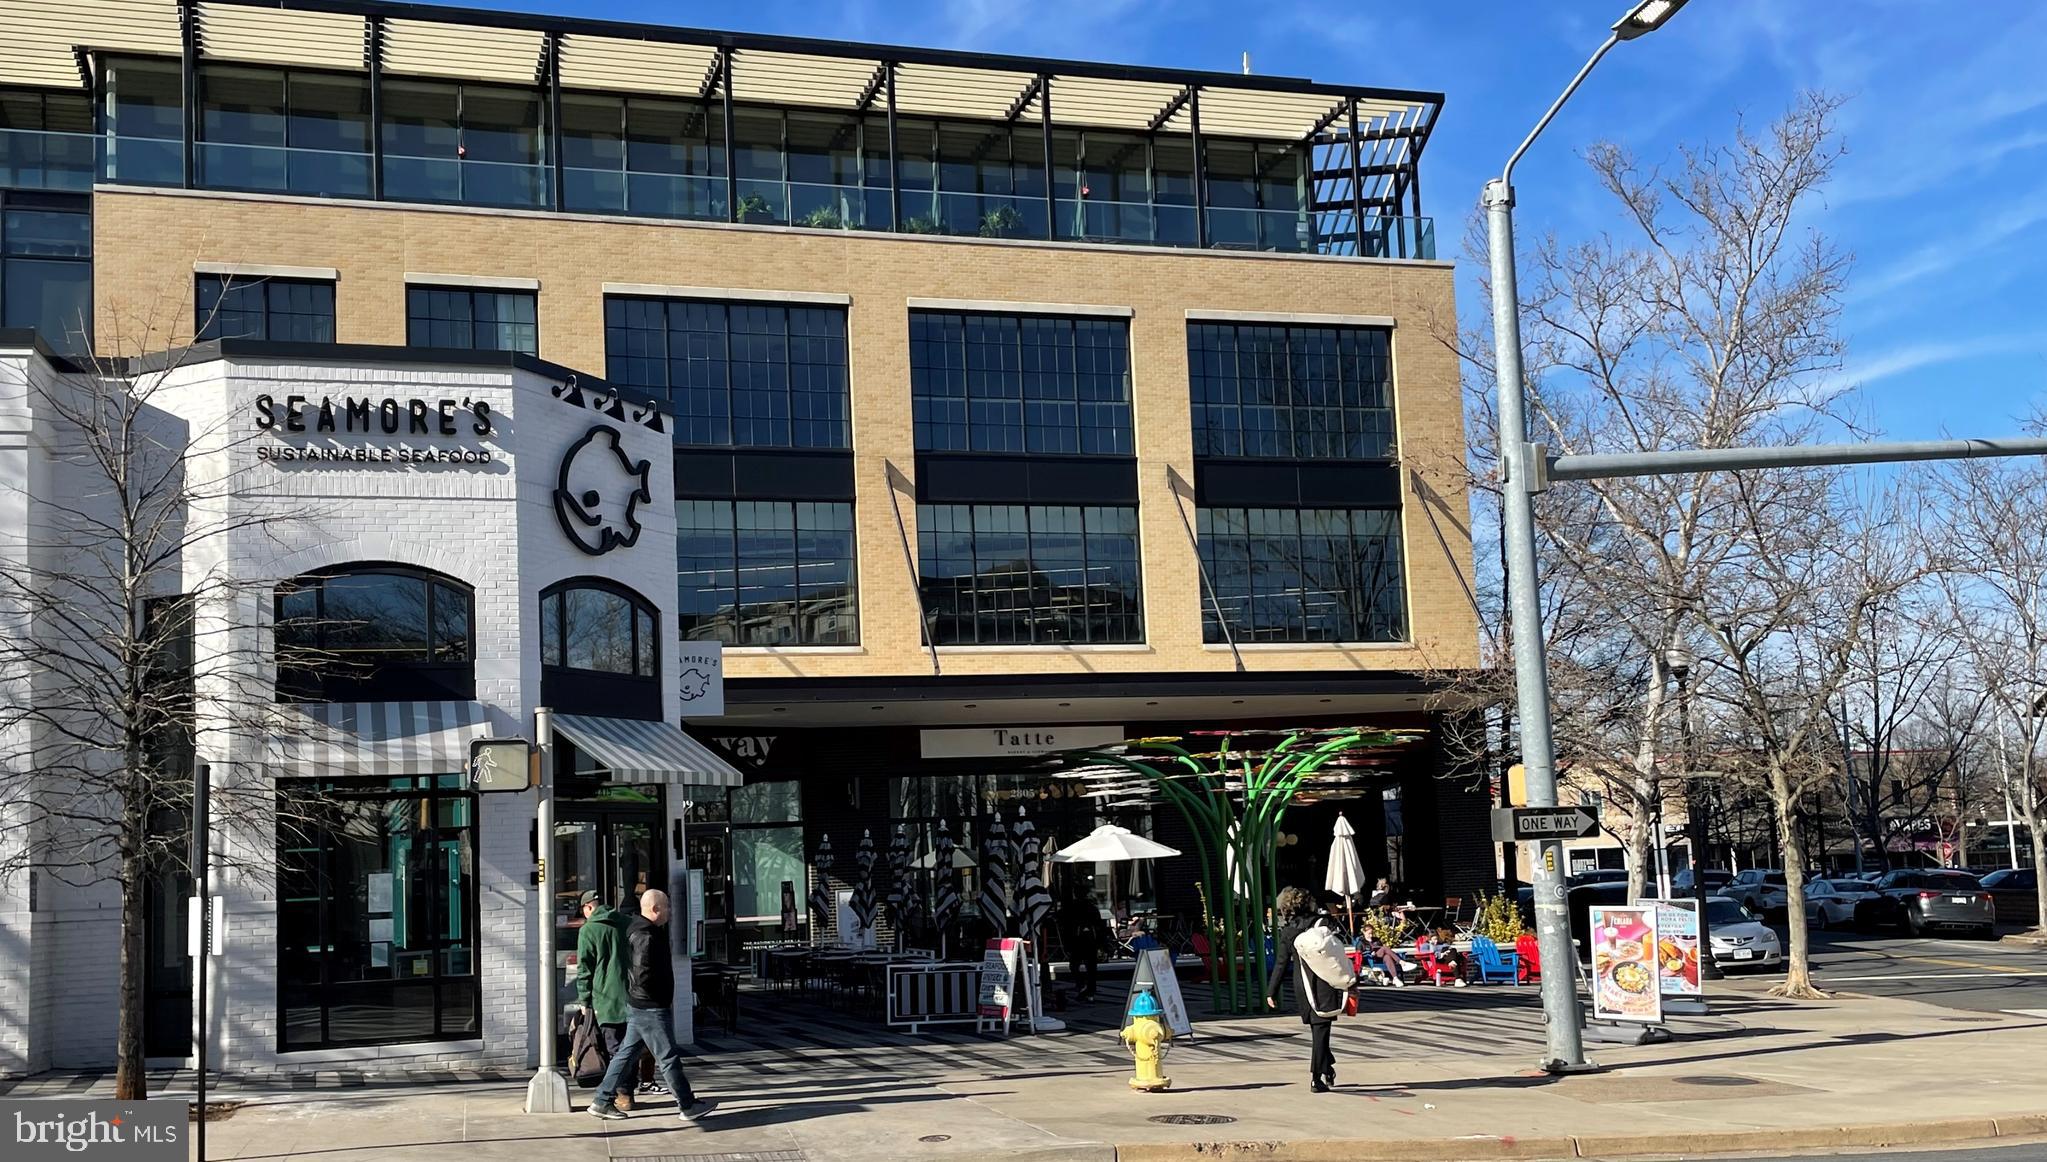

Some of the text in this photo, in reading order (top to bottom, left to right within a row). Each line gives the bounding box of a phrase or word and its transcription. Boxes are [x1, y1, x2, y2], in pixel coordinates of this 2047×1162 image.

[256, 394, 491, 436] SEAMORE'S
[257, 446, 491, 464] SUSTAINABLE SEAFOOD
[994, 729, 1055, 746] Tatte
[1010, 789, 1035, 799] 2805
[1522, 815, 1580, 831] ONE WAY
